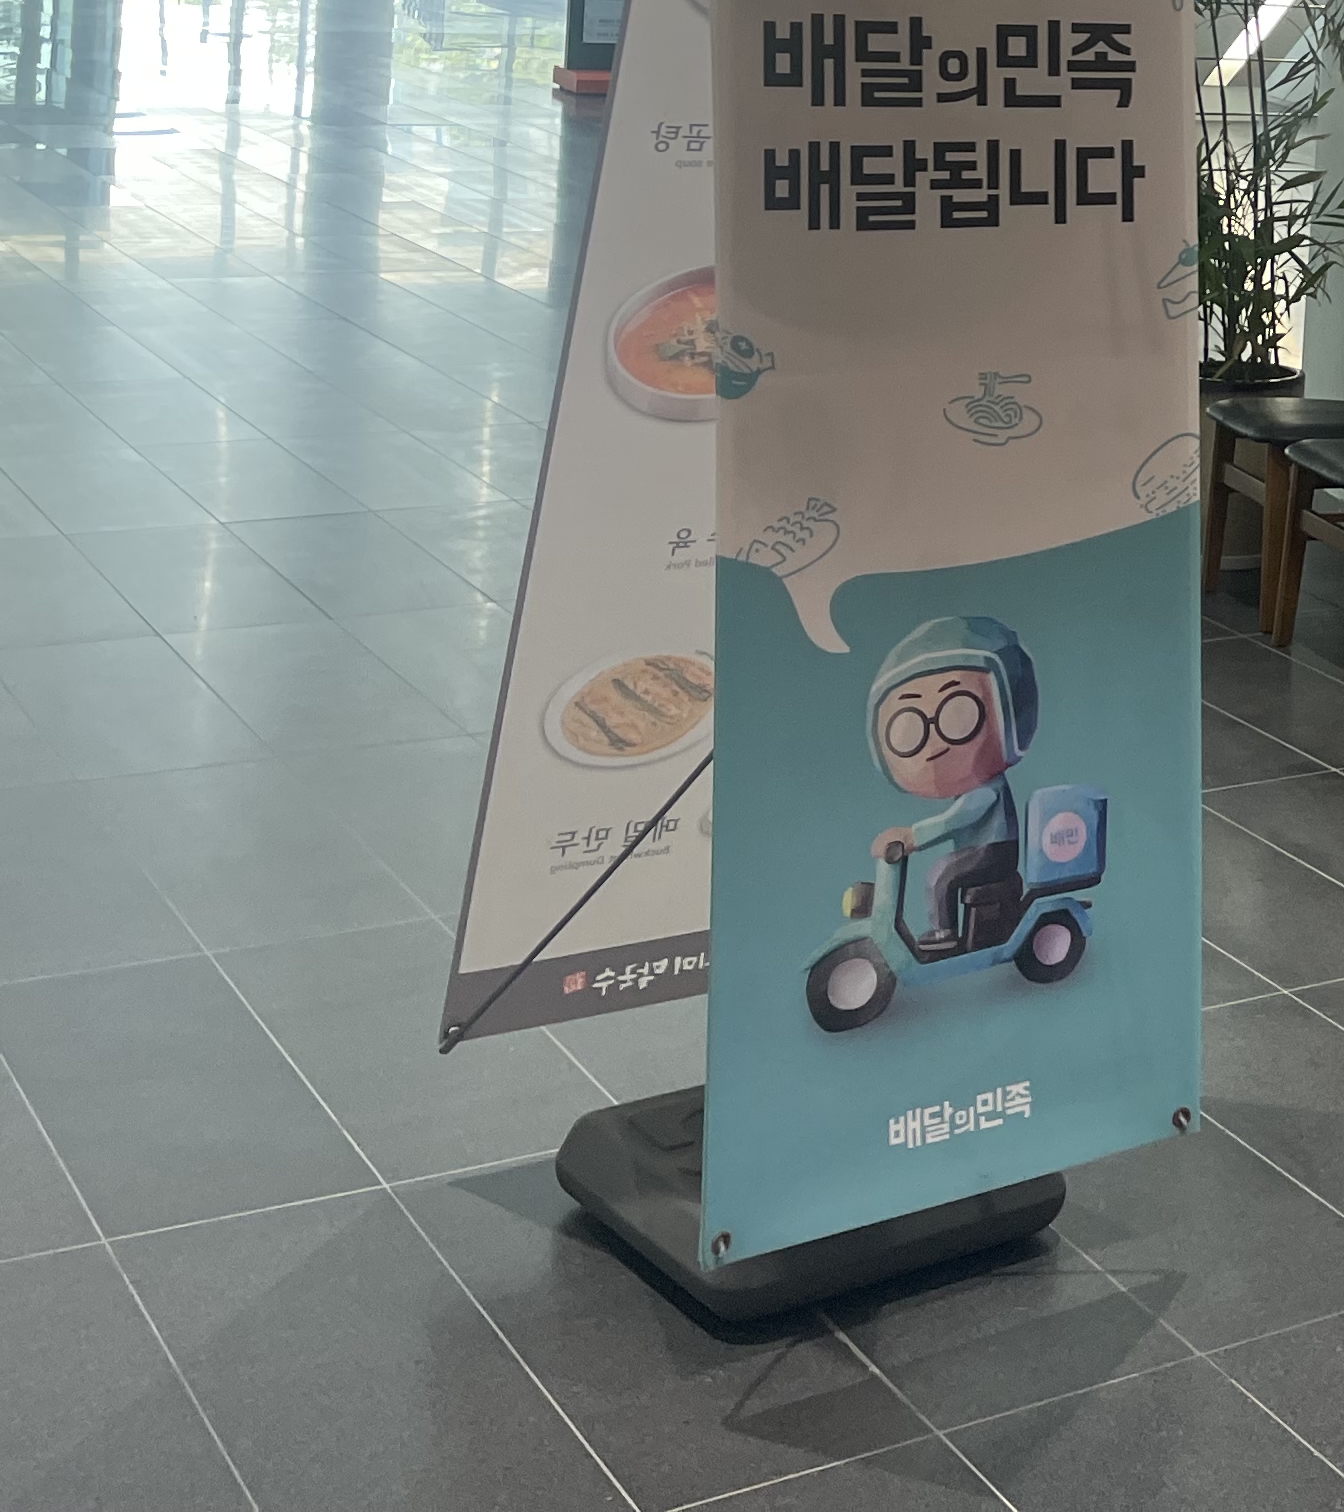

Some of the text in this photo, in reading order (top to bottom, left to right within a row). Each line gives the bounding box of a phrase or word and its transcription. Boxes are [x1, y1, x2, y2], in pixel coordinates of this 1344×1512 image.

[763, 12, 1137, 108] 배달의민족
[763, 138, 1146, 231] 배달됩니다
[887, 1080, 1033, 1149] 배달의민족
